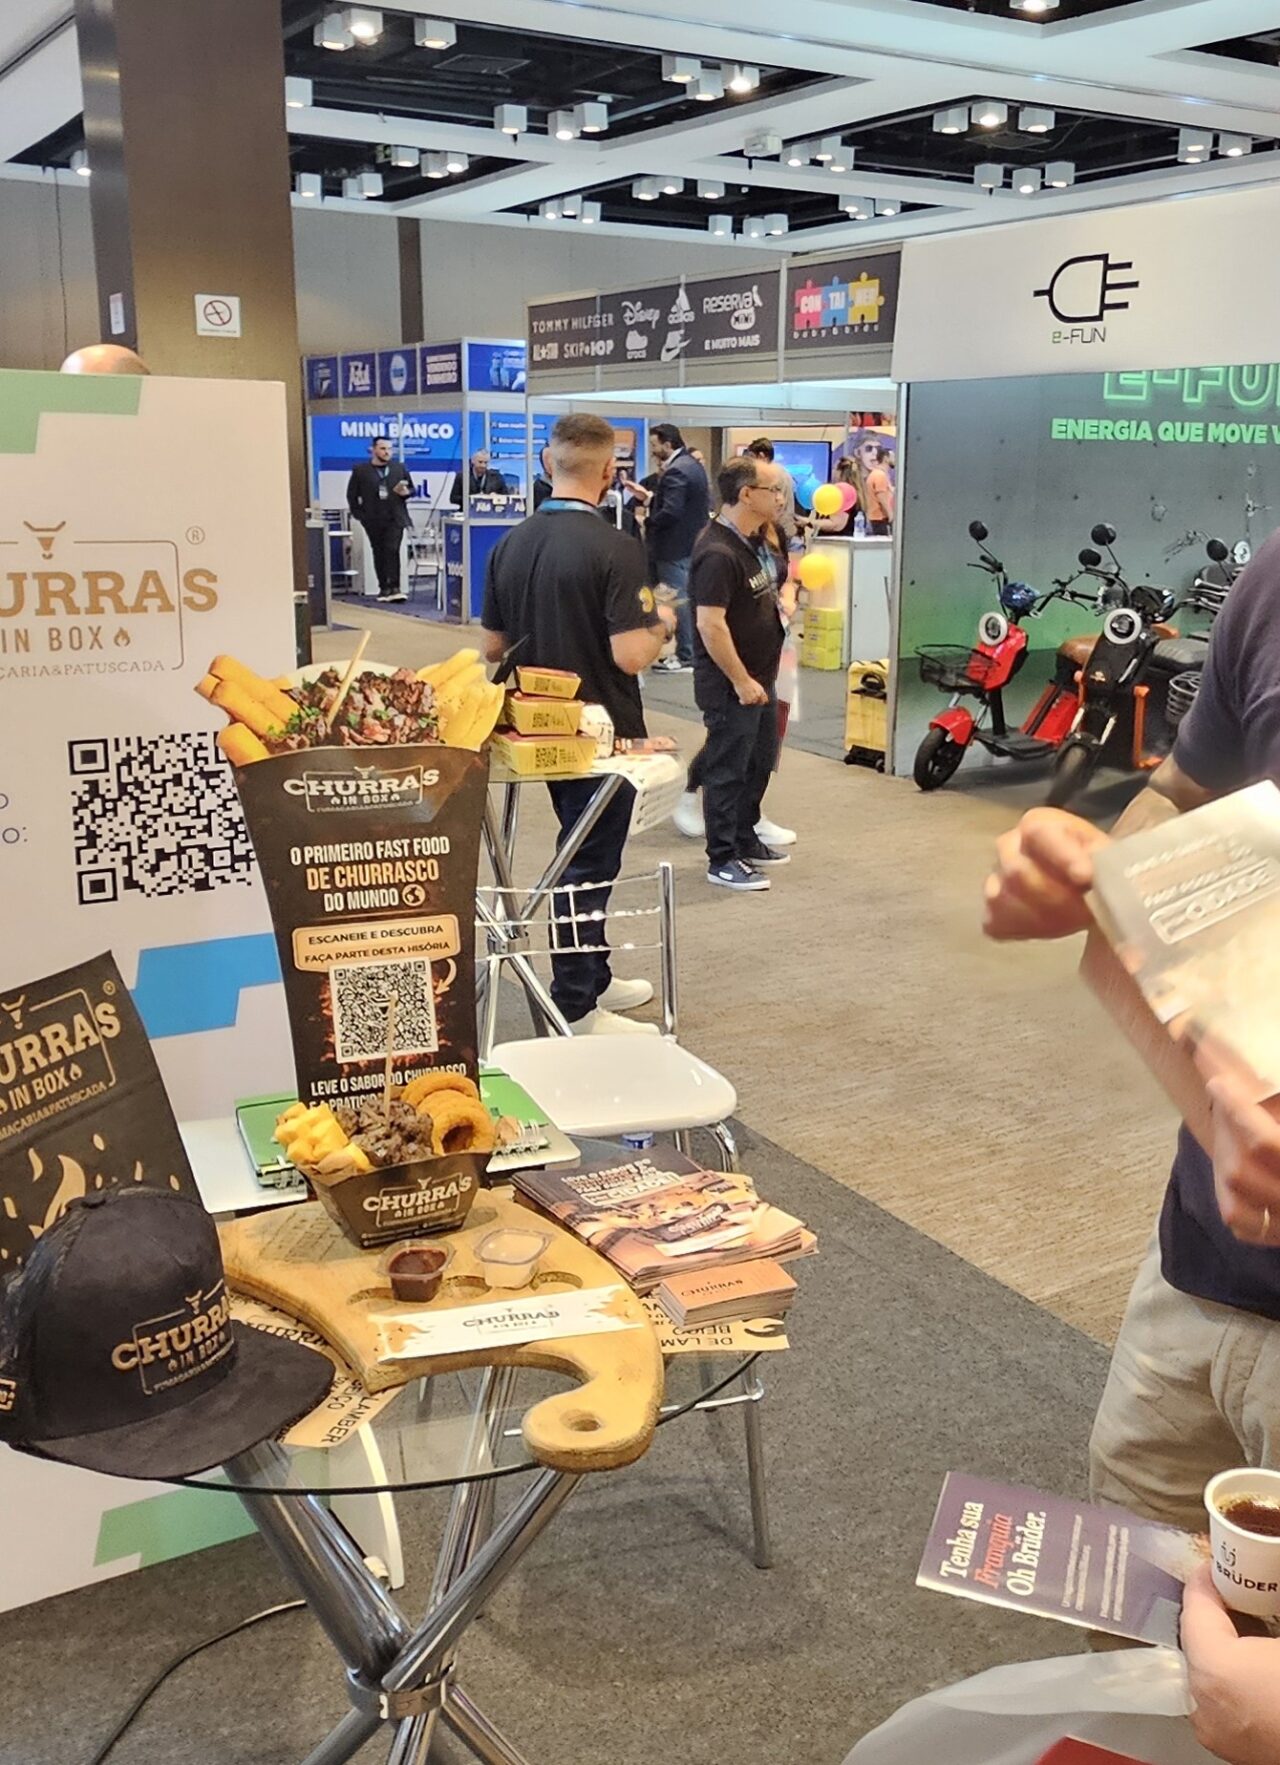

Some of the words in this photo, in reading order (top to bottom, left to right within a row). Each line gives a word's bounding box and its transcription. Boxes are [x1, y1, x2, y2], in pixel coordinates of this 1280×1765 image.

[532, 318, 568, 333] TOMMY
[341, 421, 385, 437] MINI
[389, 423, 454, 439] BANCO
[1051, 417, 1153, 441] ENERGIA
[1158, 421, 1202, 442] QUE
[1207, 423, 1267, 444] MOVE
[1, 629, 30, 653] IN
[49, 626, 104, 650] BOX
[283, 769, 440, 796] CHURRAS
[290, 847, 301, 865] O
[304, 842, 374, 864] PRIMEIRO
[376, 840, 410, 859] FAST
[413, 836, 450, 857] FOOD
[306, 867, 331, 890] DE
[334, 859, 439, 888] CHURRASCO
[324, 893, 344, 912] DO
[347, 888, 399, 909] MUNDO
[308, 931, 368, 945] ESCANEIE
[371, 930, 378, 939] E
[380, 925, 444, 939] DESCUBRA
[304, 953, 334, 965] FAÇA
[335, 949, 370, 960] PARTE
[372, 946, 406, 956] DESTA
[407, 941, 450, 953] HISÓRIA
[8, 1084, 31, 1111] IN
[32, 1066, 70, 1100] BOX
[311, 1079, 339, 1096] LEVE
[340, 1078, 349, 1092] O
[349, 1073, 386, 1091] SABOR
[363, 1177, 472, 1212] CHURRAS
[321, 1396, 379, 1443] LAMBER
[940, 1528, 978, 1578] Tenha
[960, 1501, 985, 1530] sua
[974, 1513, 1015, 1590] Franquia
[1011, 1511, 1047, 1569] Brüder.
[1006, 1571, 1037, 1596] Oh
[1216, 1560, 1279, 1593] BRÜDER
